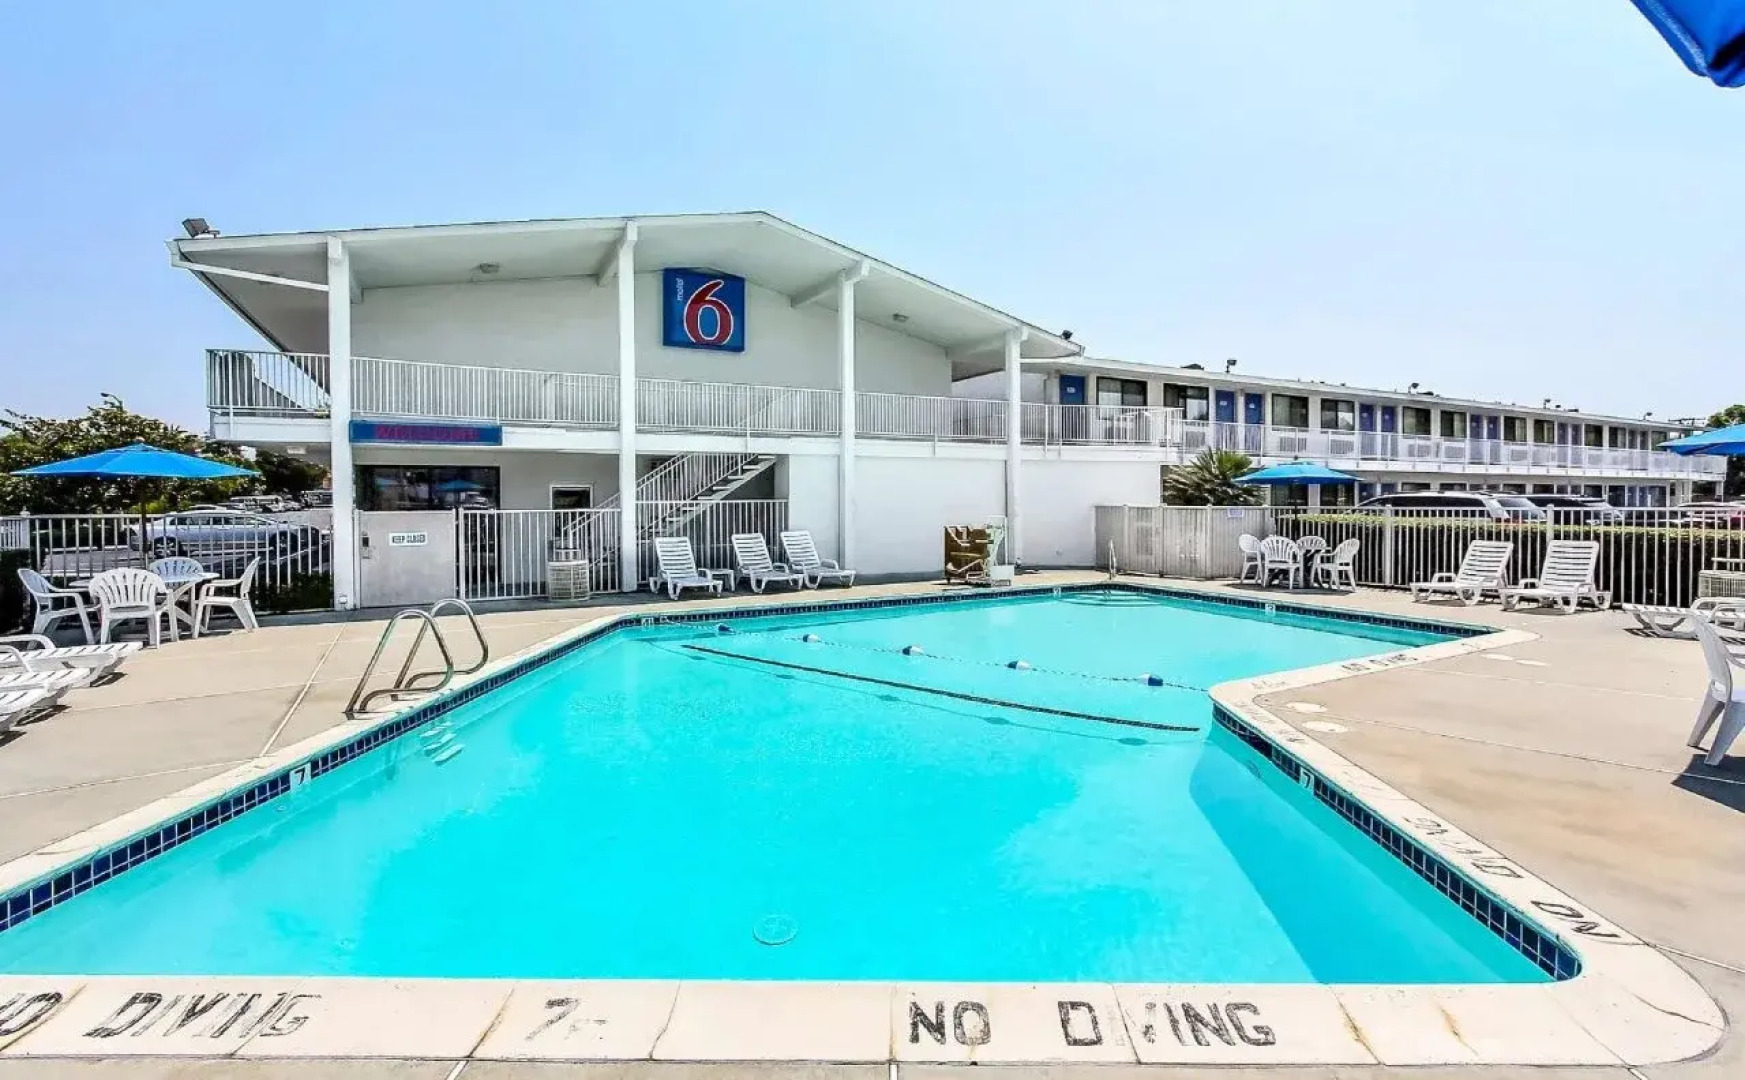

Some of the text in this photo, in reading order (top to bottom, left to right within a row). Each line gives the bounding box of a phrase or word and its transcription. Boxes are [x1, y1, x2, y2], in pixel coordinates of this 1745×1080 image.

[683, 280, 734, 346] 6
[1531, 900, 1621, 938] NO
[82, 992, 322, 1039] DIVING
[909, 1000, 1277, 1047] NO DING
